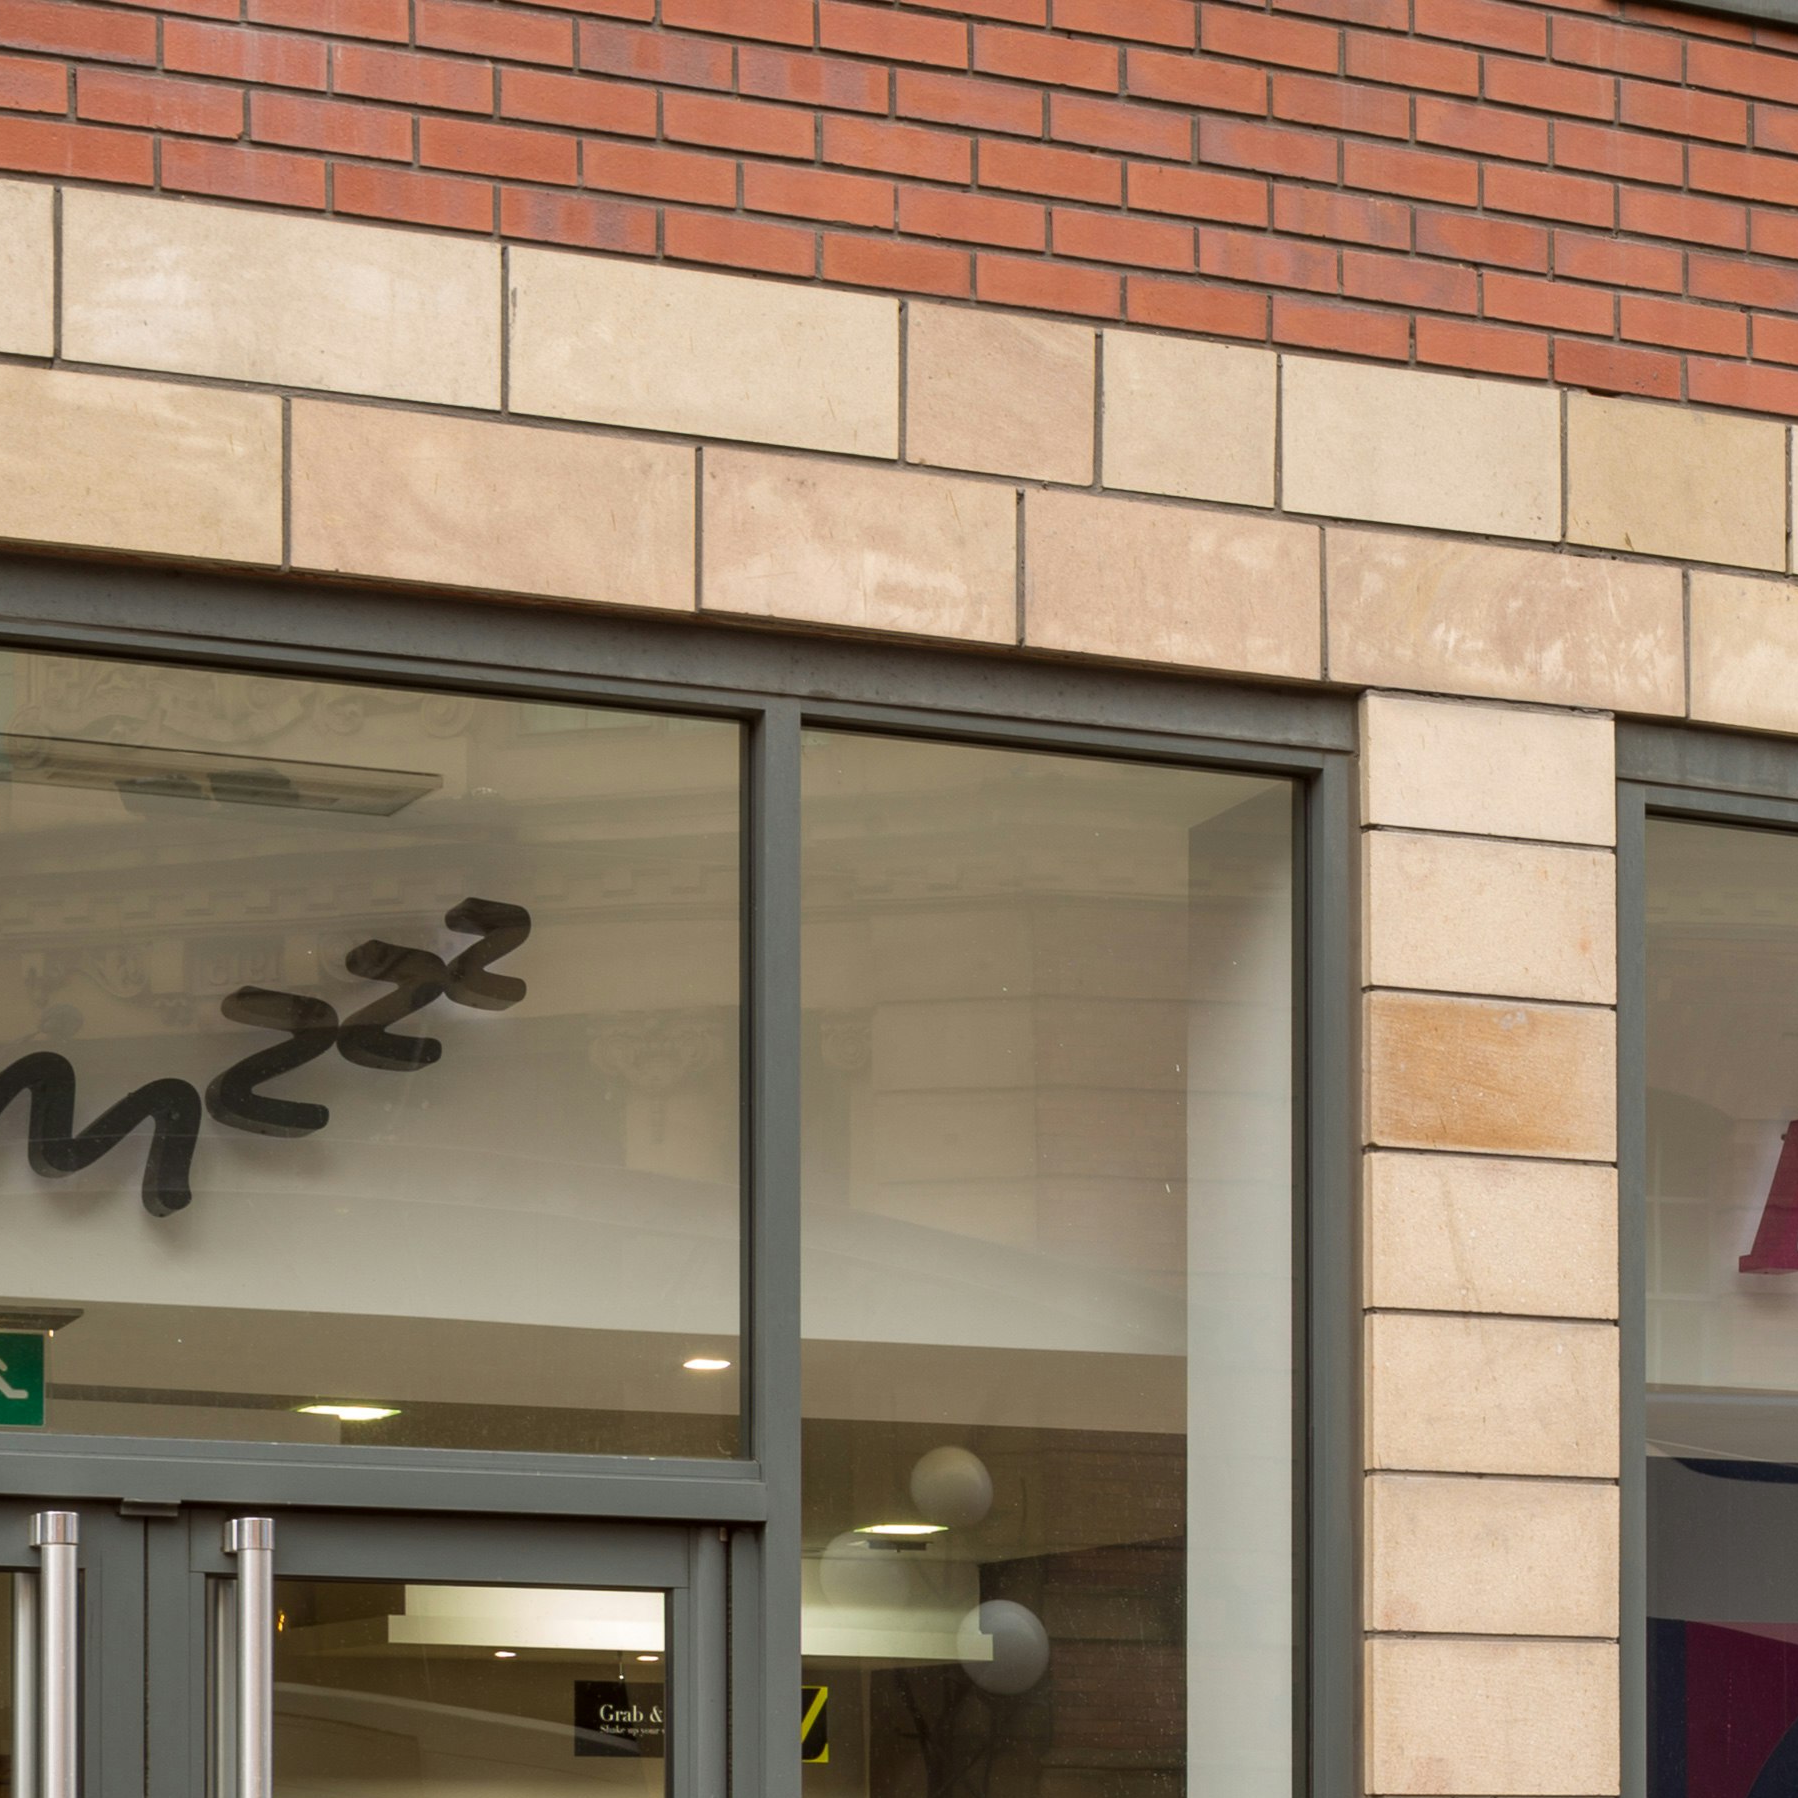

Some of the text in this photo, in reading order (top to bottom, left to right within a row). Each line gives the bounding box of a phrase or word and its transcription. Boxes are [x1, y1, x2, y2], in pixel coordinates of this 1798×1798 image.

[599, 1704, 664, 1723] Grab &
[600, 1725, 626, 1735] Shake
